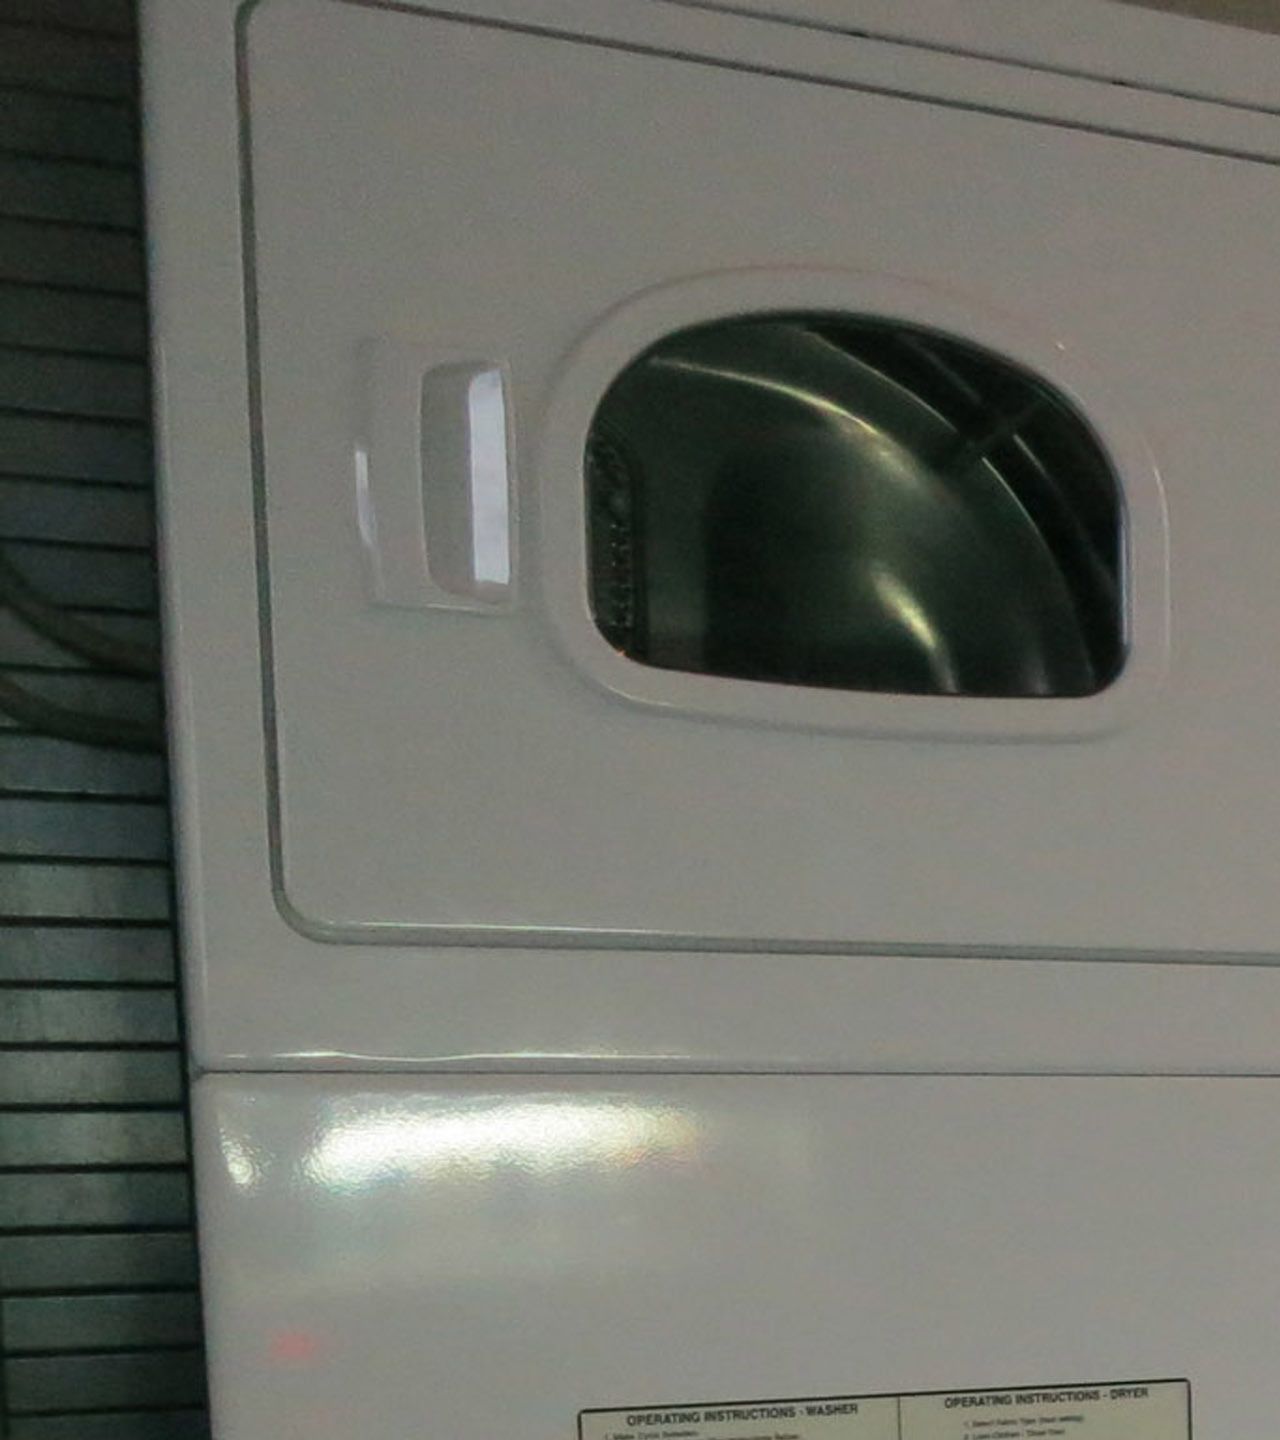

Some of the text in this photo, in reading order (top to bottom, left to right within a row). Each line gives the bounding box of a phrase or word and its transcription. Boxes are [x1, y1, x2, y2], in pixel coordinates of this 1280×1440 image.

[945, 1395, 1012, 1409] OPERATING
[1016, 1390, 1100, 1405] INSTRUCTIONS
[1111, 1387, 1148, 1400] DRYER
[627, 1411, 699, 1426] OPERATING
[704, 1407, 796, 1422] INSTRUCTIONS
[807, 1404, 858, 1418] WASHER
